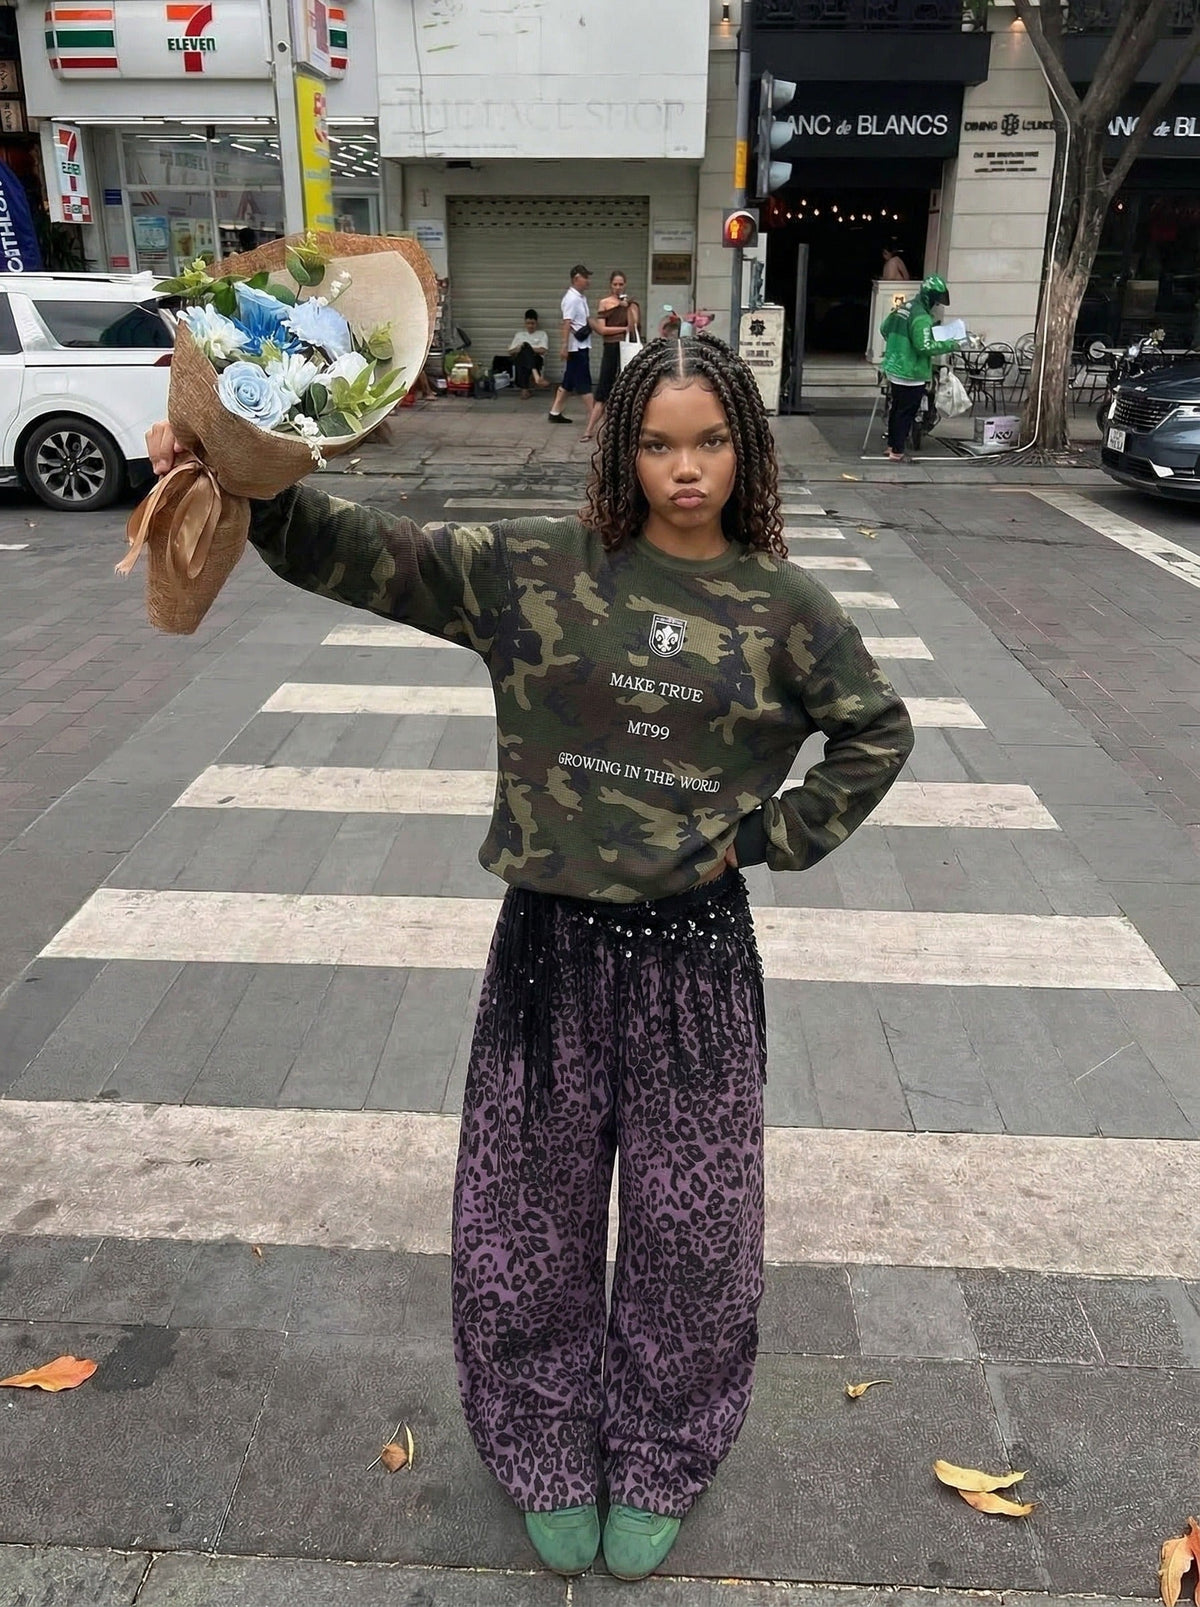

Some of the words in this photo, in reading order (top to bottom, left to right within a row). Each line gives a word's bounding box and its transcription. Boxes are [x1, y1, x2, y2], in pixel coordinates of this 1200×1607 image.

[166, 3, 212, 72] 7
[835, 119, 851, 135] de
[857, 114, 948, 135] BLANCS
[609, 672, 655, 693] MAKE
[658, 682, 704, 703] TRUE
[626, 719, 670, 740] MT99
[558, 751, 622, 776] GROWING
[624, 764, 641, 779] IN
[644, 768, 675, 786] THE
[680, 775, 721, 793] WORLD
